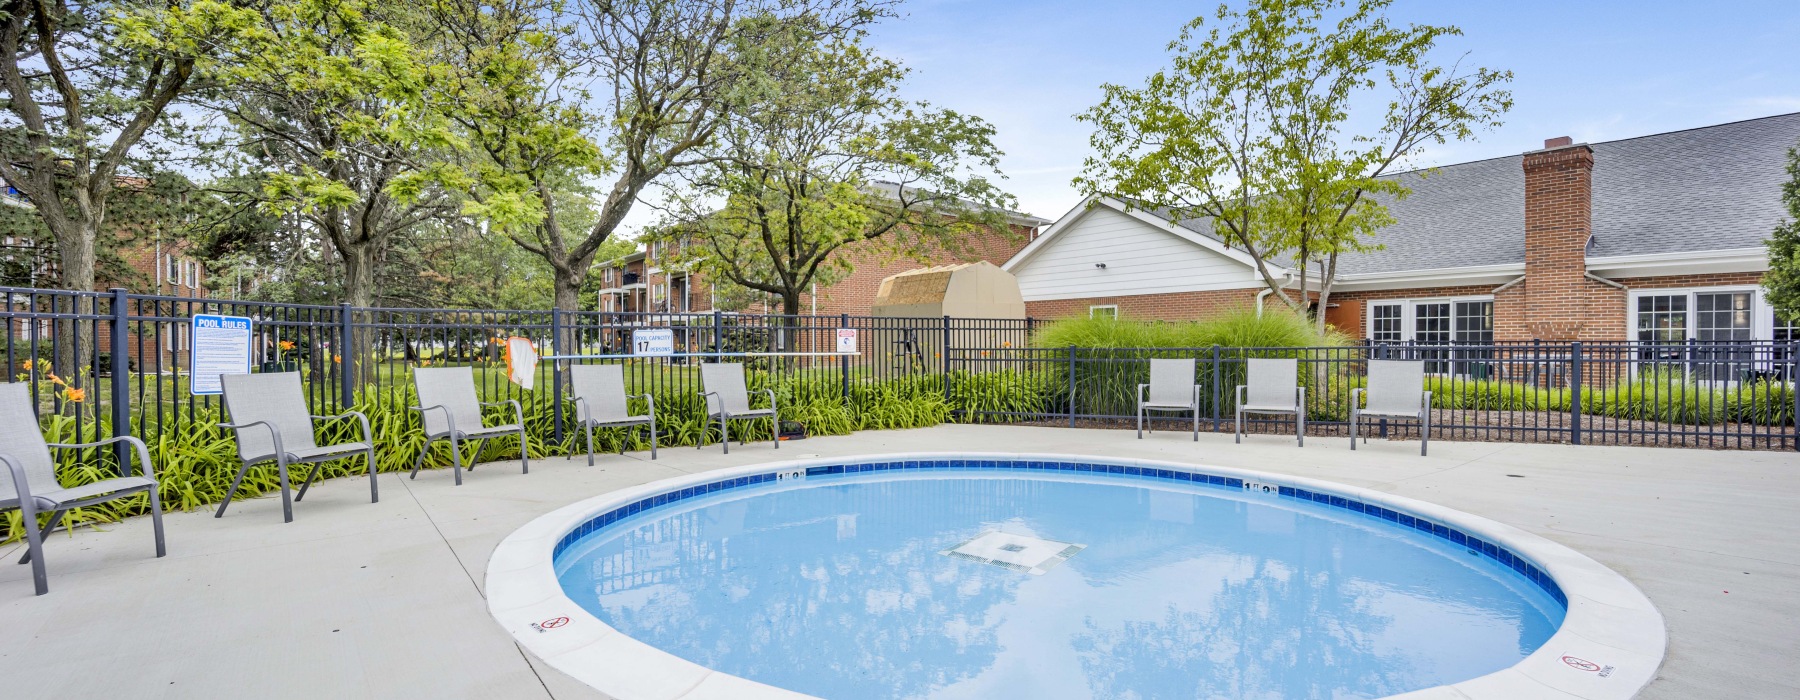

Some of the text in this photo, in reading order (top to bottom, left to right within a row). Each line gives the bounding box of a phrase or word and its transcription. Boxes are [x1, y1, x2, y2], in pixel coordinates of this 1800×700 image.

[198, 318, 247, 329] POOL RULES
[638, 341, 649, 352] 17
